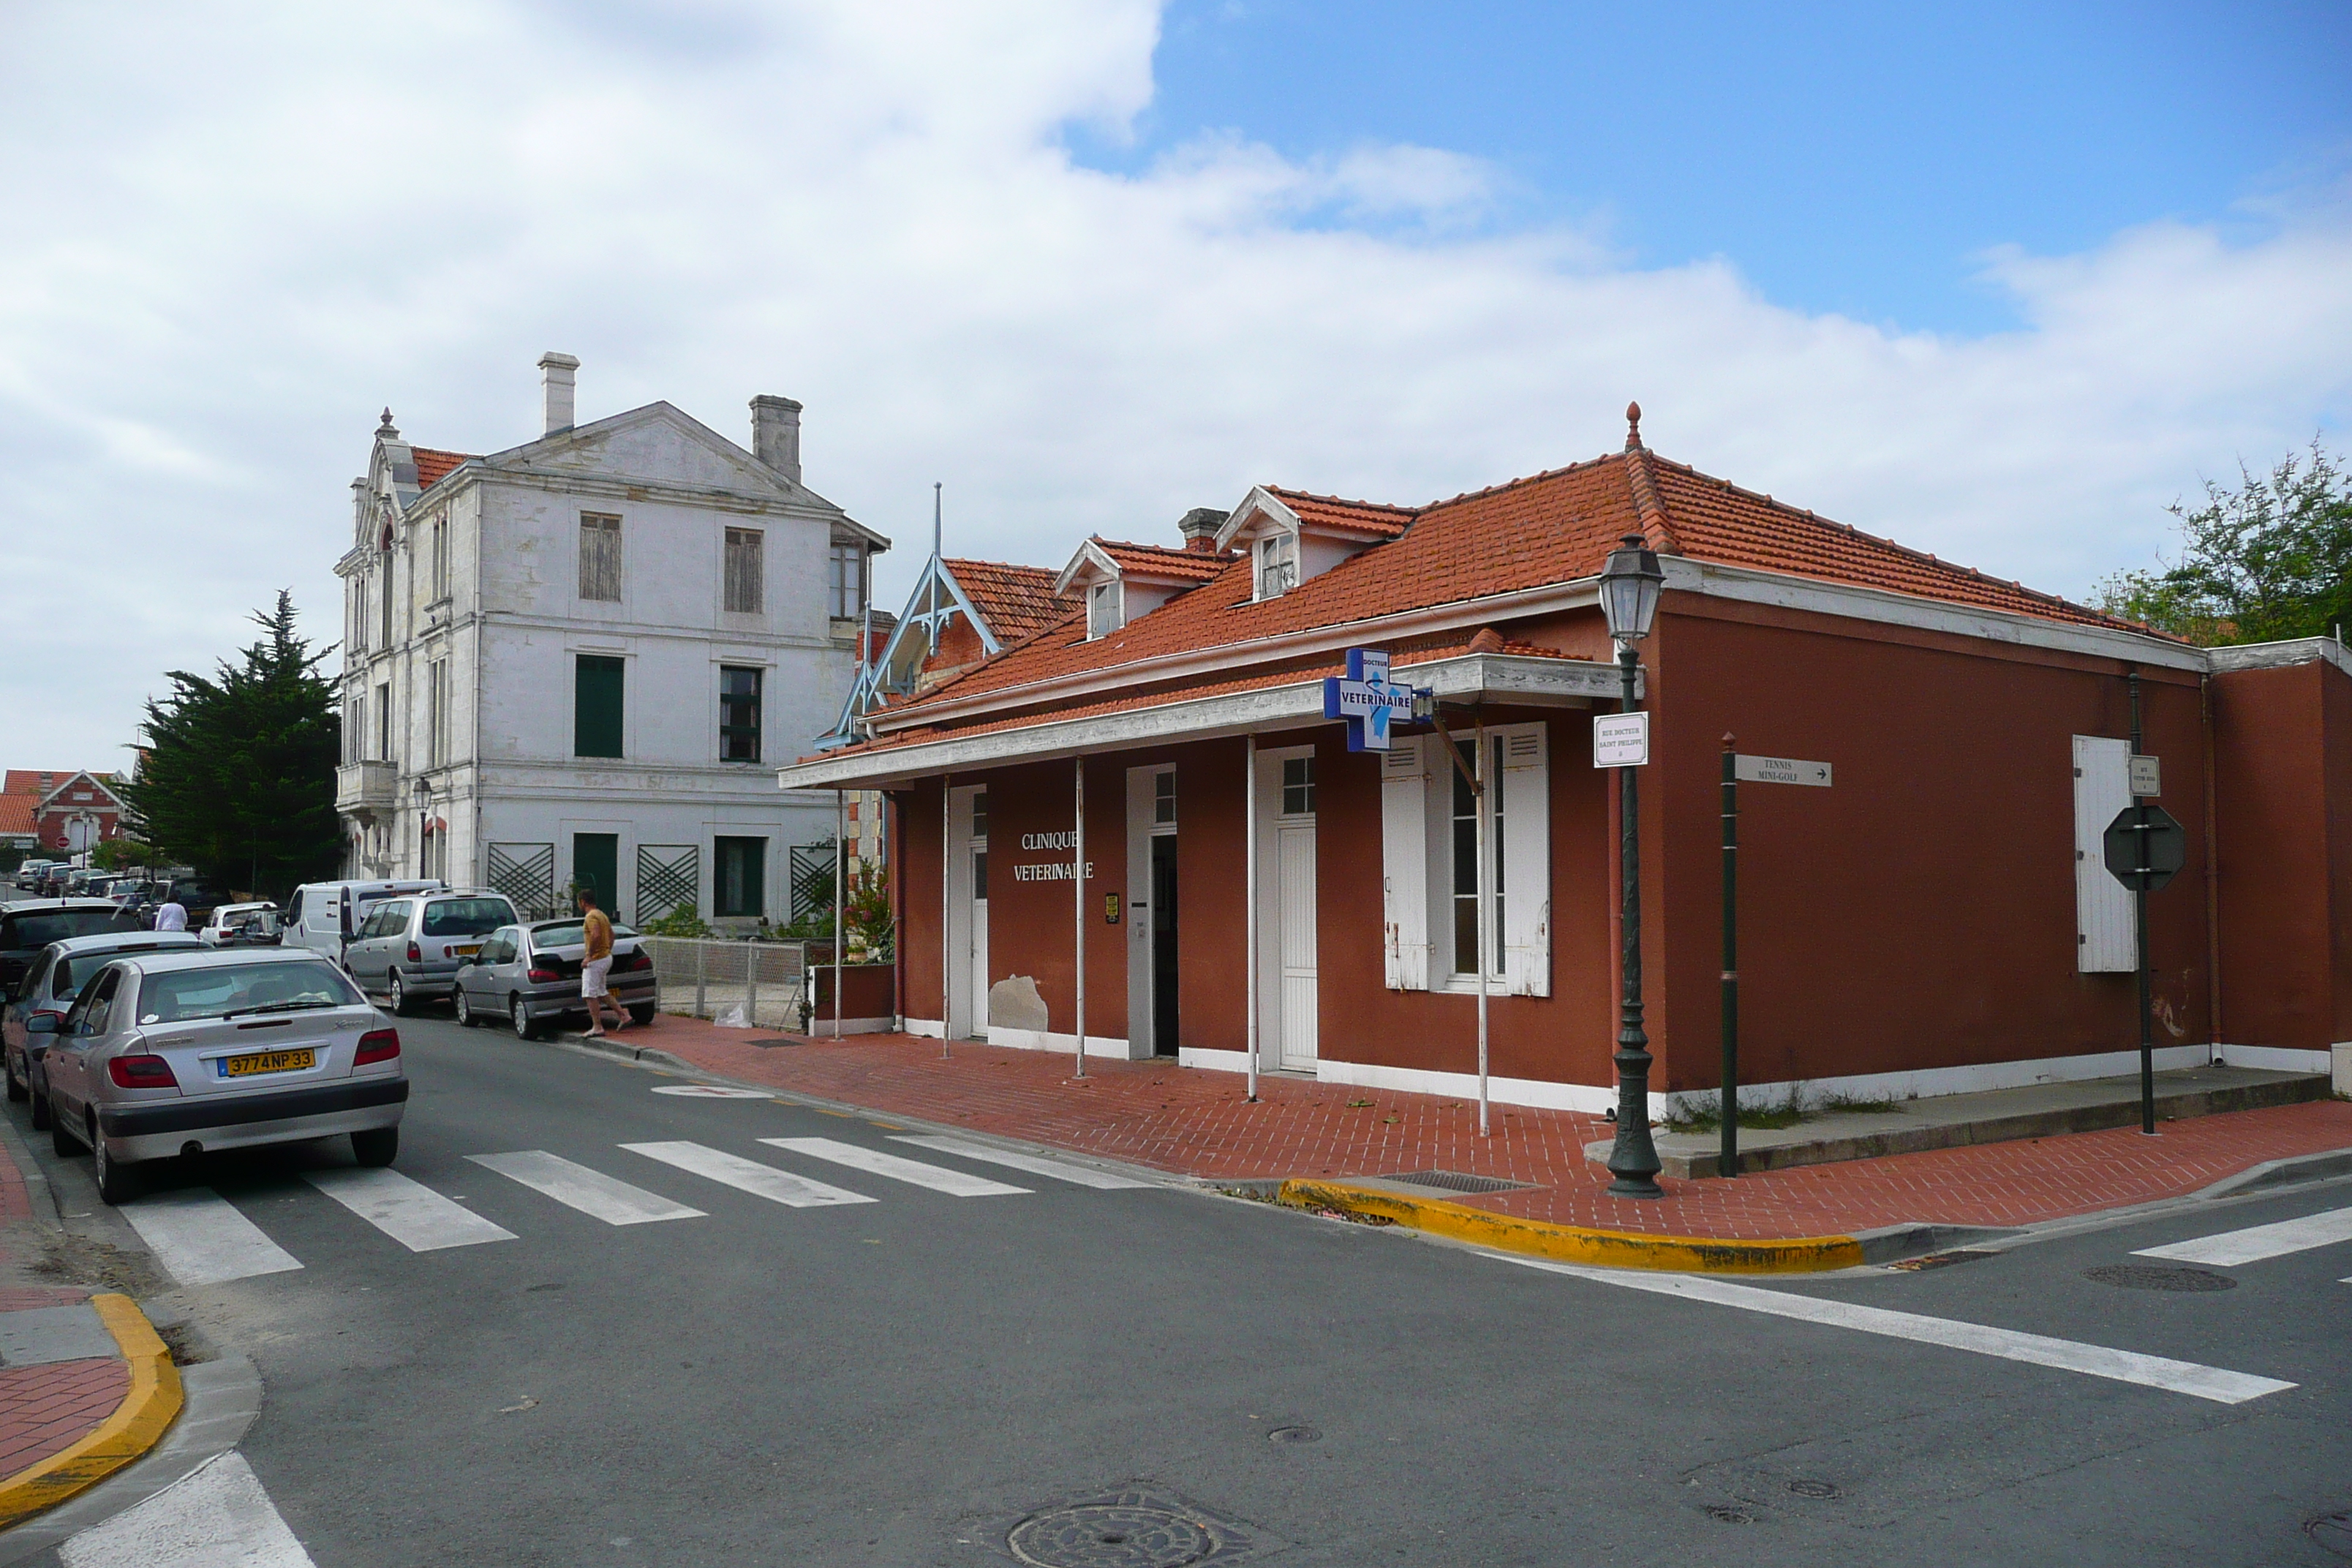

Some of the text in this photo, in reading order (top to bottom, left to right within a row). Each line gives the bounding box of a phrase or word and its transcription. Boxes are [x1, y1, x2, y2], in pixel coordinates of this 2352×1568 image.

[1363, 659, 1387, 667] DOCTEUR
[1341, 691, 1410, 708] VETERINAIRE
[1614, 727, 1640, 736] DOCTEUR
[1618, 739, 1643, 747] PHILIPPE
[1764, 759, 1793, 770] TENNIS
[1758, 770, 1798, 782] MINI-GOLF
[1022, 831, 1077, 851] CLINIQUE
